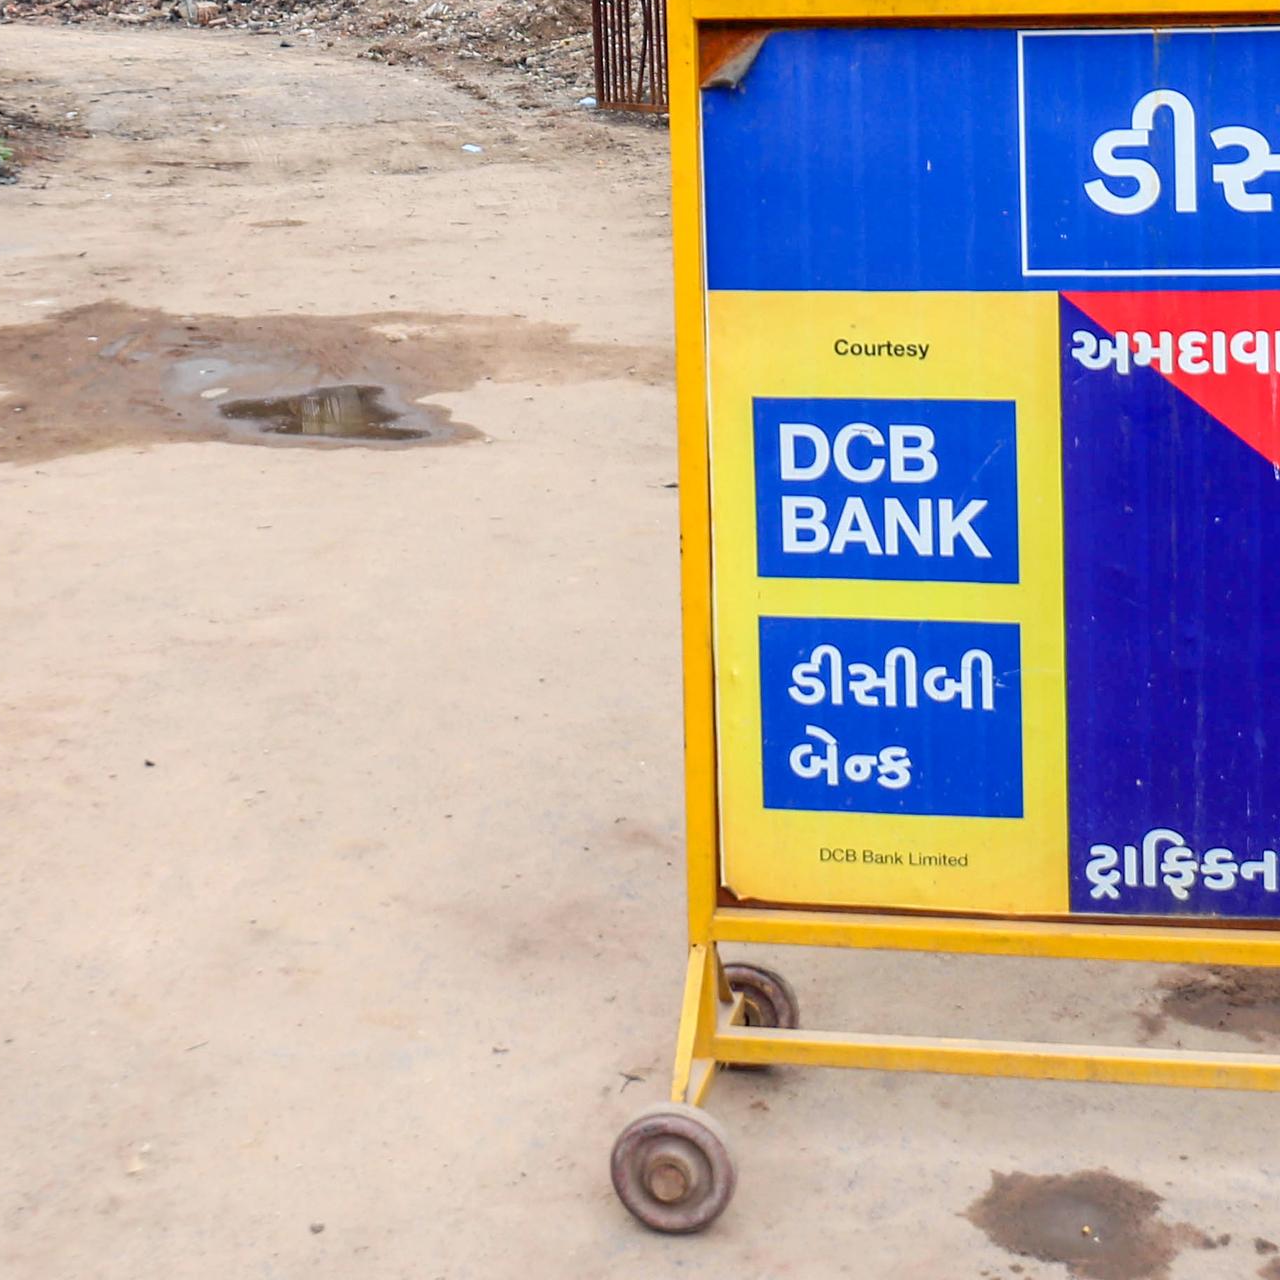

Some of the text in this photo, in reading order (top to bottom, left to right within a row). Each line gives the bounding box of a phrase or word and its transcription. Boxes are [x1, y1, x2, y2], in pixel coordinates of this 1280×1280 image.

[834, 339, 930, 360] Courtesy
[779, 422, 939, 483] DCB
[781, 496, 992, 558] BANK
[788, 644, 996, 711] ડીસીબી
[789, 725, 913, 790] બેન્ક
[819, 848, 969, 869] DCB Bank Limited
